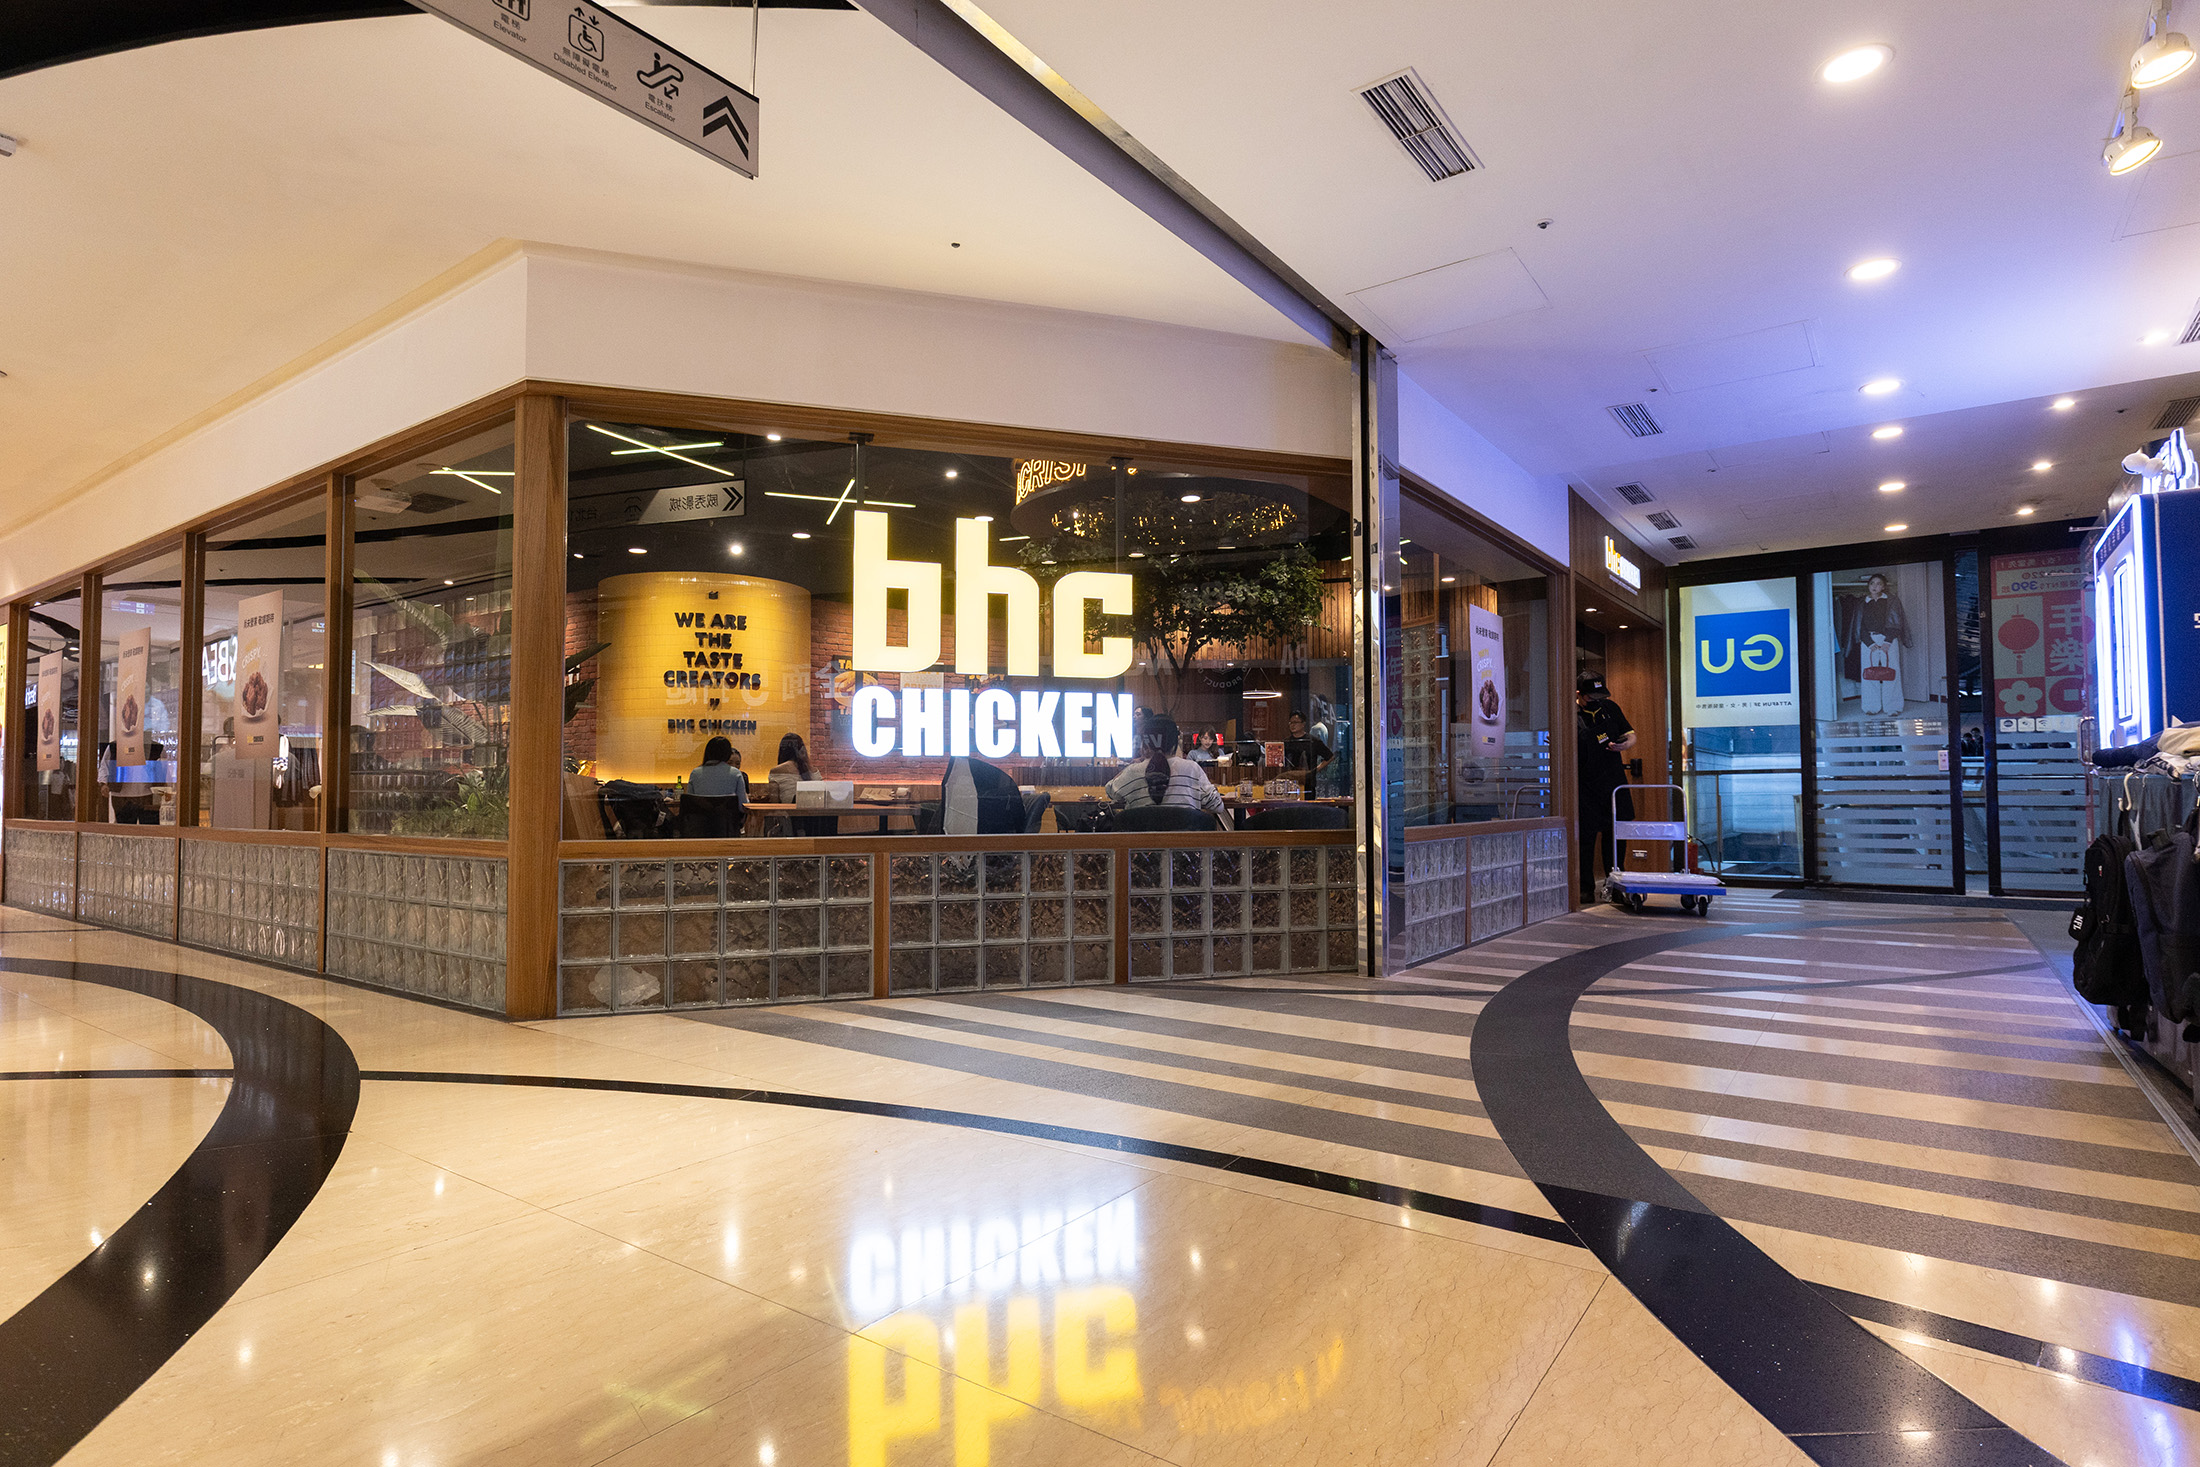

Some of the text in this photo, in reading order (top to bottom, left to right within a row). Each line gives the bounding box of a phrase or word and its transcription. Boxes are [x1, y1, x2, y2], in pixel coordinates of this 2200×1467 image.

[500, 13, 521, 30] 電梯
[493, 20, 527, 43] Elevator
[553, 53, 618, 92] Disabled Elevator
[644, 101, 676, 122] Escalator
[648, 93, 673, 112] 電扶梯
[852, 510, 1133, 679] bhc
[674, 612, 747, 630] WE ARE
[695, 632, 732, 649] THE
[683, 651, 743, 669] TASTE
[663, 670, 761, 690] CREATORS
[667, 719, 757, 732] BHC CHICKEN
[852, 686, 1133, 758] CHICKEN
